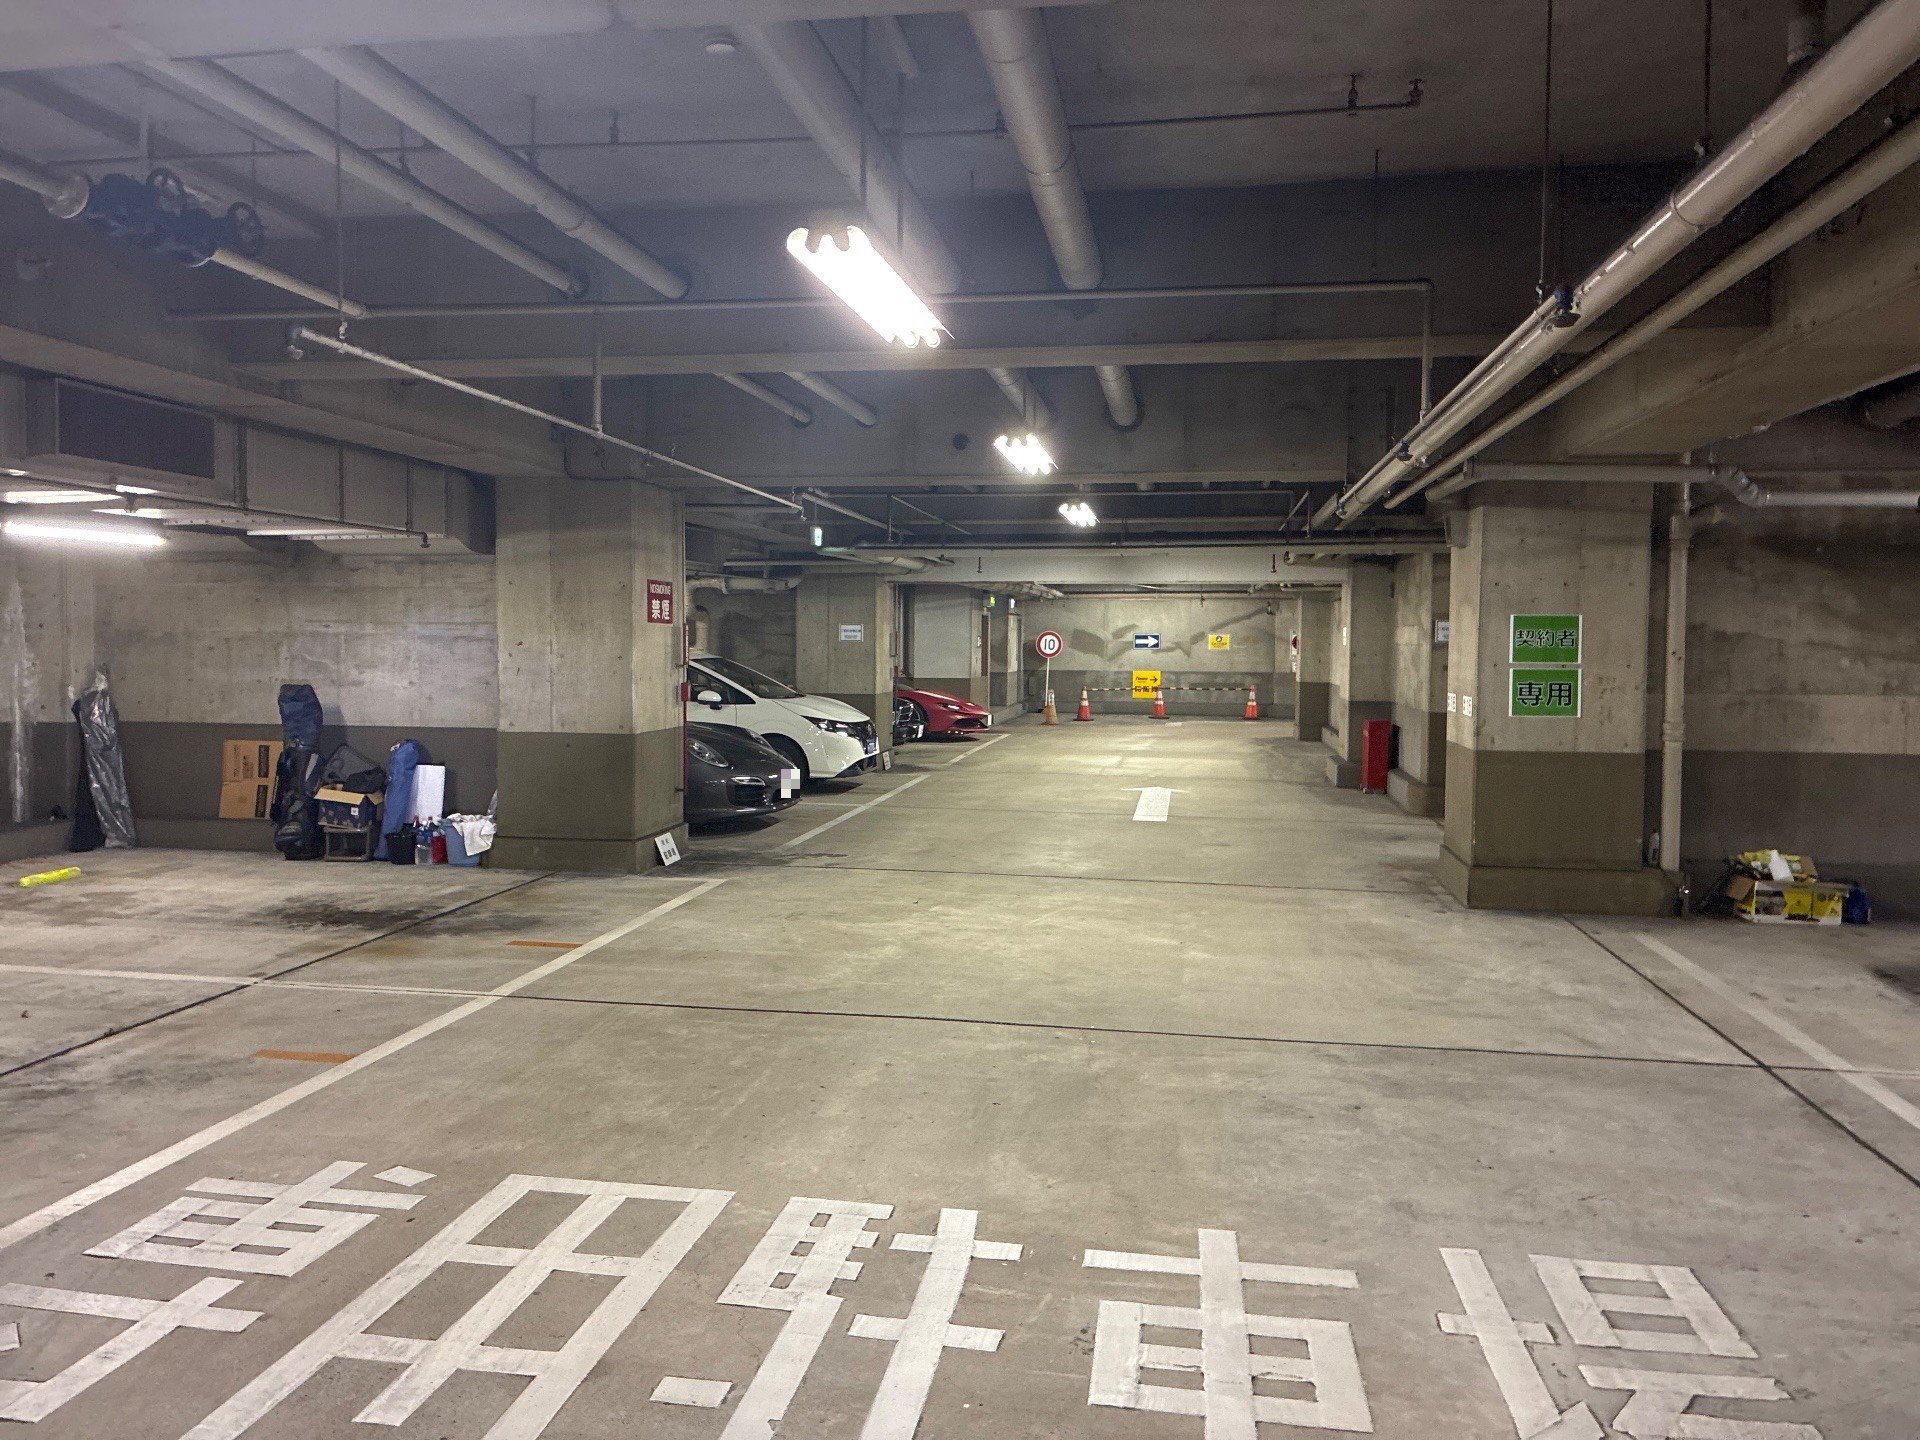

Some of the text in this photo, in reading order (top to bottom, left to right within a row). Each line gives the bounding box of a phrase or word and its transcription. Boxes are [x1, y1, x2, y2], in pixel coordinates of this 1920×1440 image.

[652, 599, 670, 620] 禁煙
[1044, 638, 1056, 651] 10
[1515, 629, 1576, 648] 契約者
[1516, 681, 1573, 707] 専用
